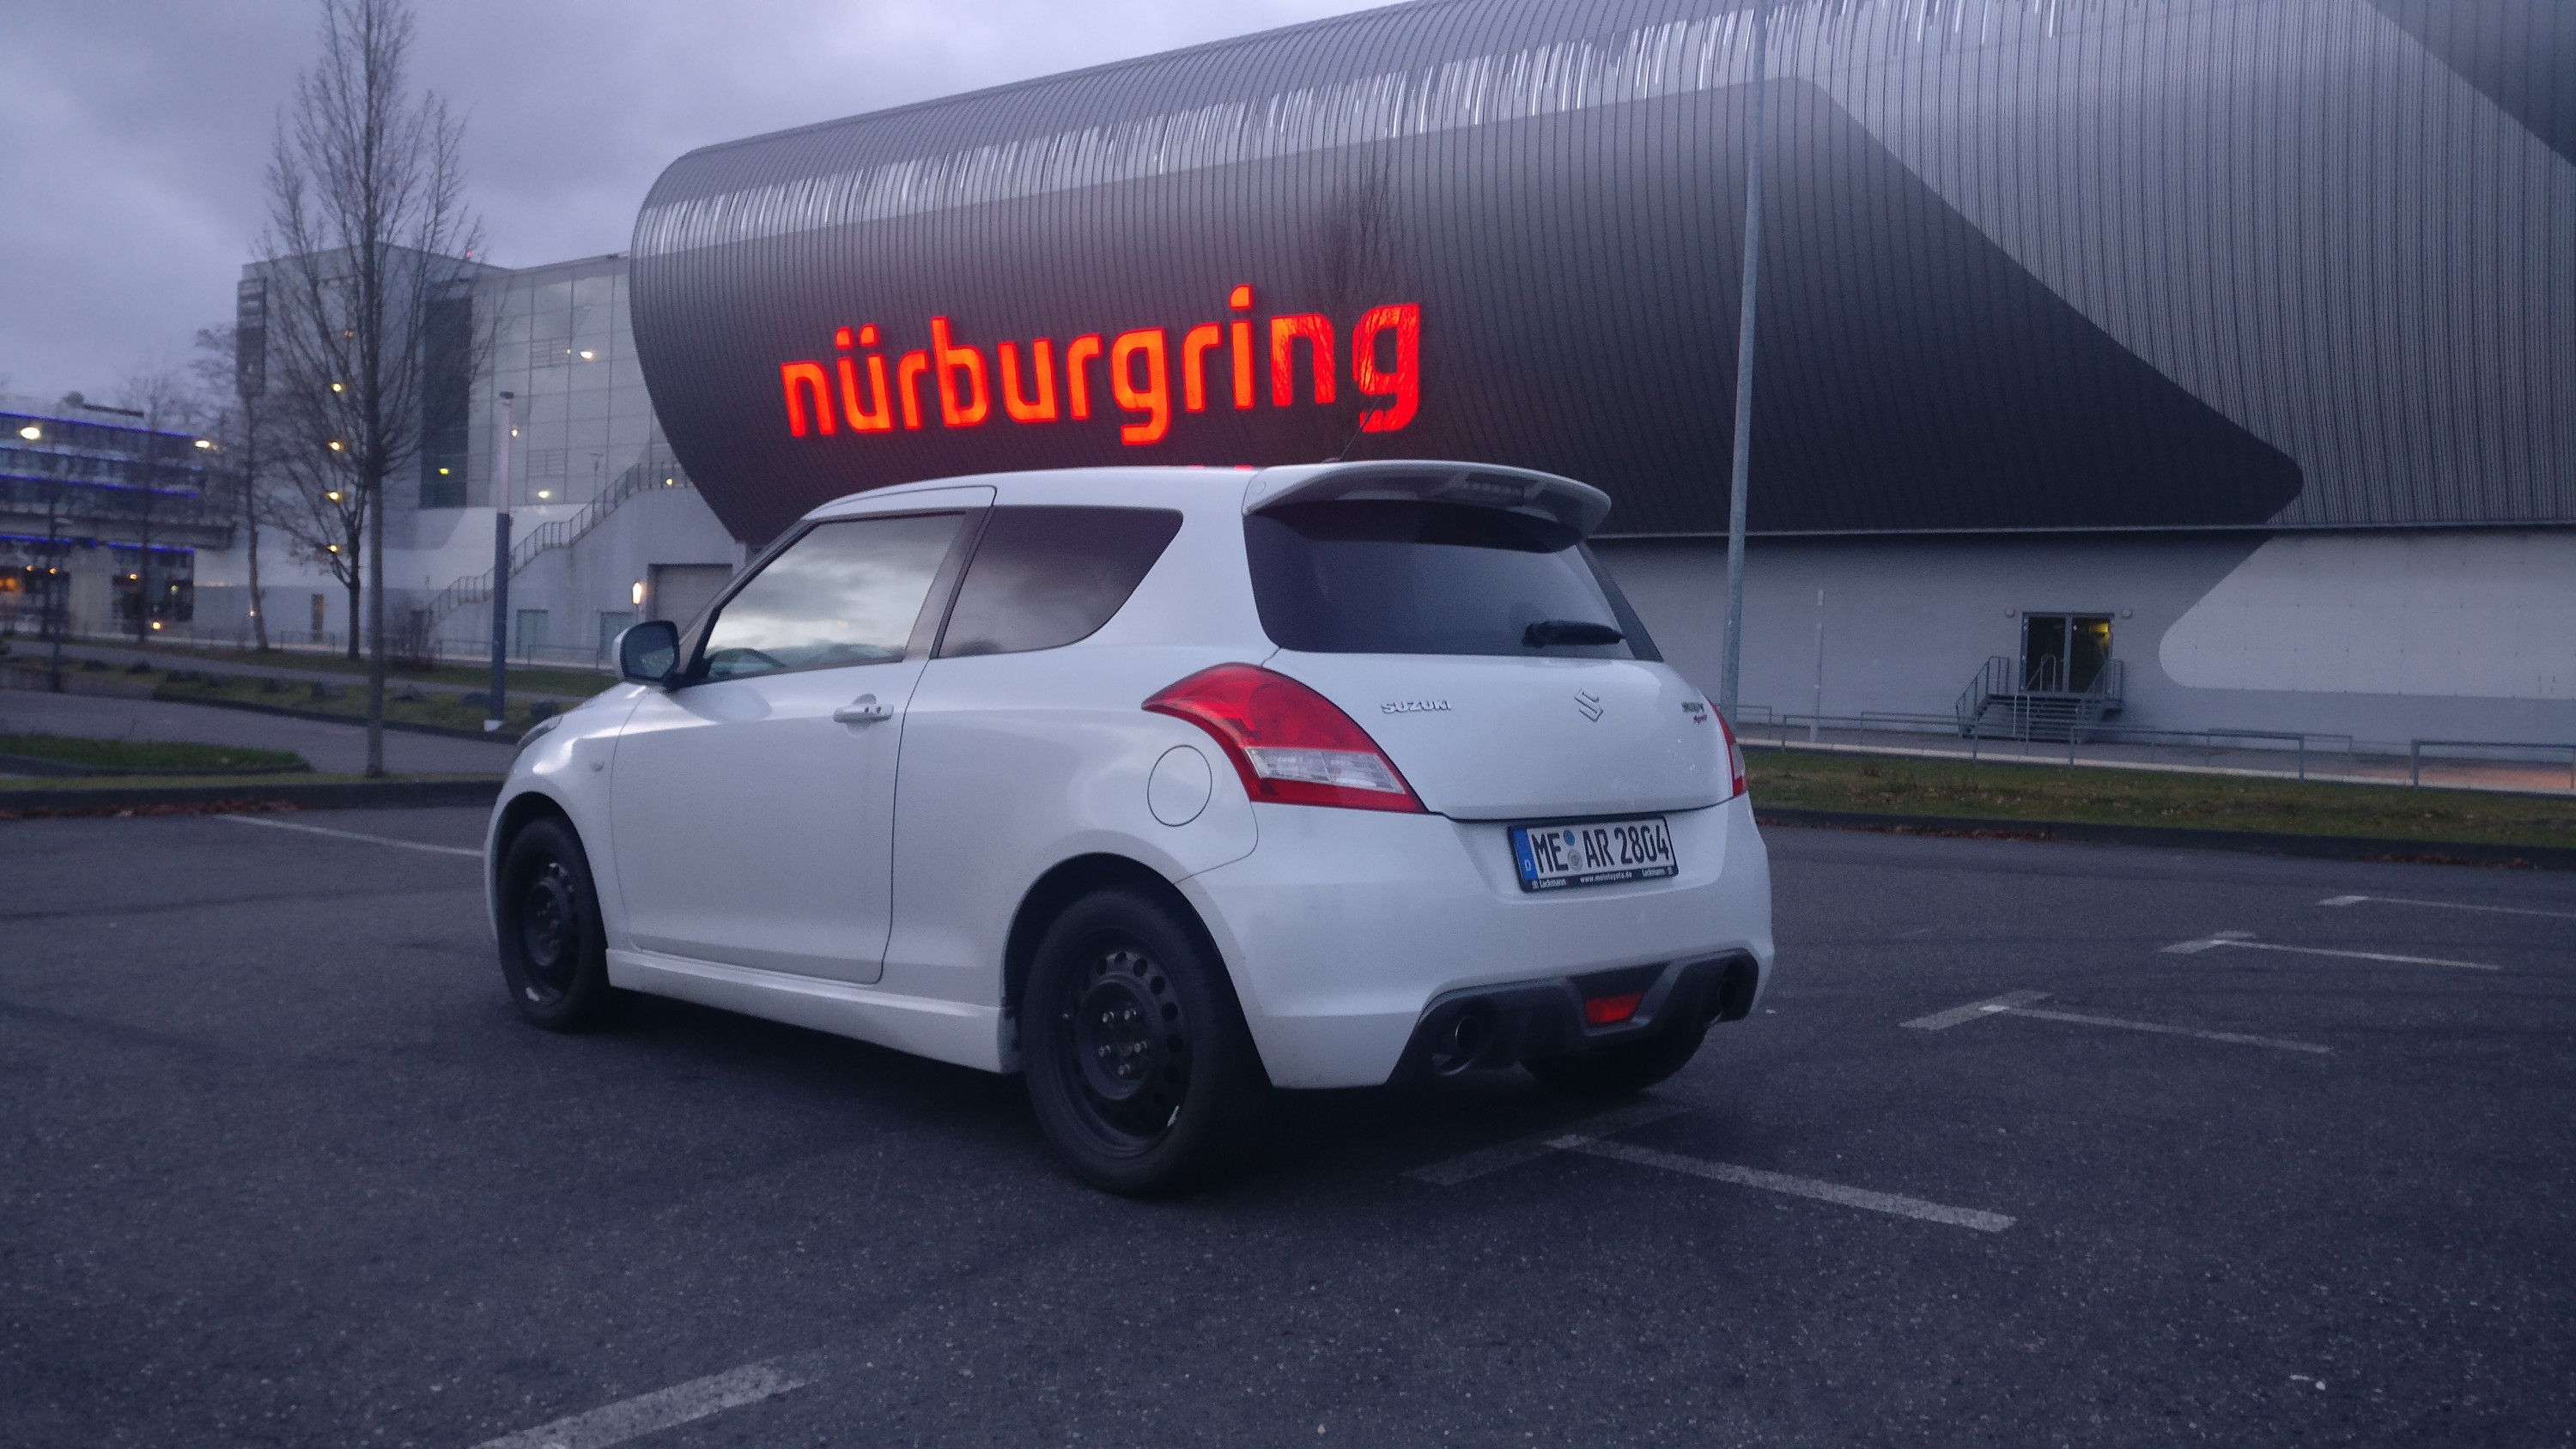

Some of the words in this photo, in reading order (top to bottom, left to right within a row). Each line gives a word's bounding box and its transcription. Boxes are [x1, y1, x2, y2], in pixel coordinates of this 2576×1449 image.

[780, 283, 1422, 446] nürburgring
[1380, 699, 1452, 715] SUZUKI
[1531, 833, 1569, 873] ME
[1583, 828, 1614, 868] AR
[1614, 825, 1669, 864] 2804
[1525, 860, 1532, 871] D
